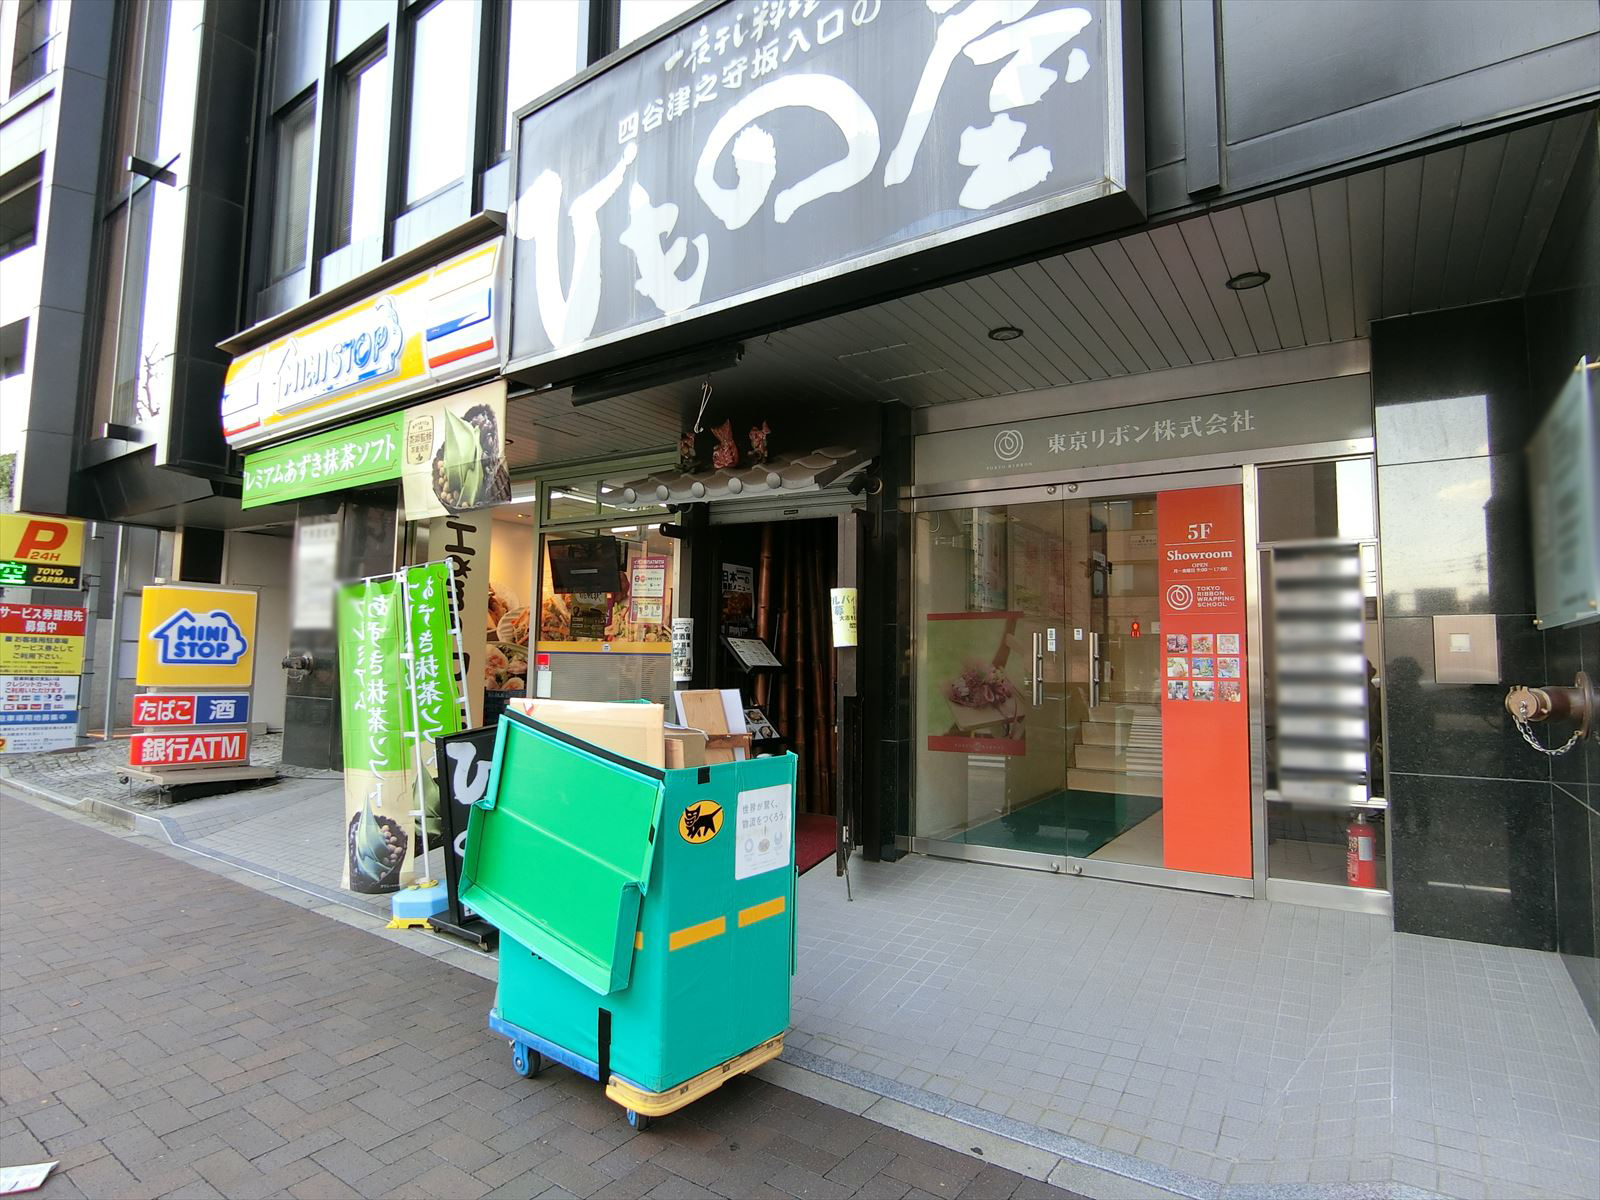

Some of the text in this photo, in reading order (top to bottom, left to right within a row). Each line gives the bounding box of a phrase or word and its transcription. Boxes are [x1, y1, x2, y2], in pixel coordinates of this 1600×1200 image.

[1047, 409, 1256, 455] 東京リボン株式会社
[243, 432, 396, 491] レミアムあずき抹茶ソフト
[14, 520, 69, 558] P
[1187, 522, 1213, 540] 5F
[30, 551, 61, 561] 24H
[1166, 550, 1233, 561] Showroom
[33, 575, 76, 584] CARMAX
[37, 567, 64, 576] TOYO
[25, 620, 57, 633] 募集中
[177, 625, 228, 641] MINI
[174, 642, 230, 658] STOP
[138, 700, 236, 721] たばこ 酒
[141, 736, 241, 762] 銀行ATM
